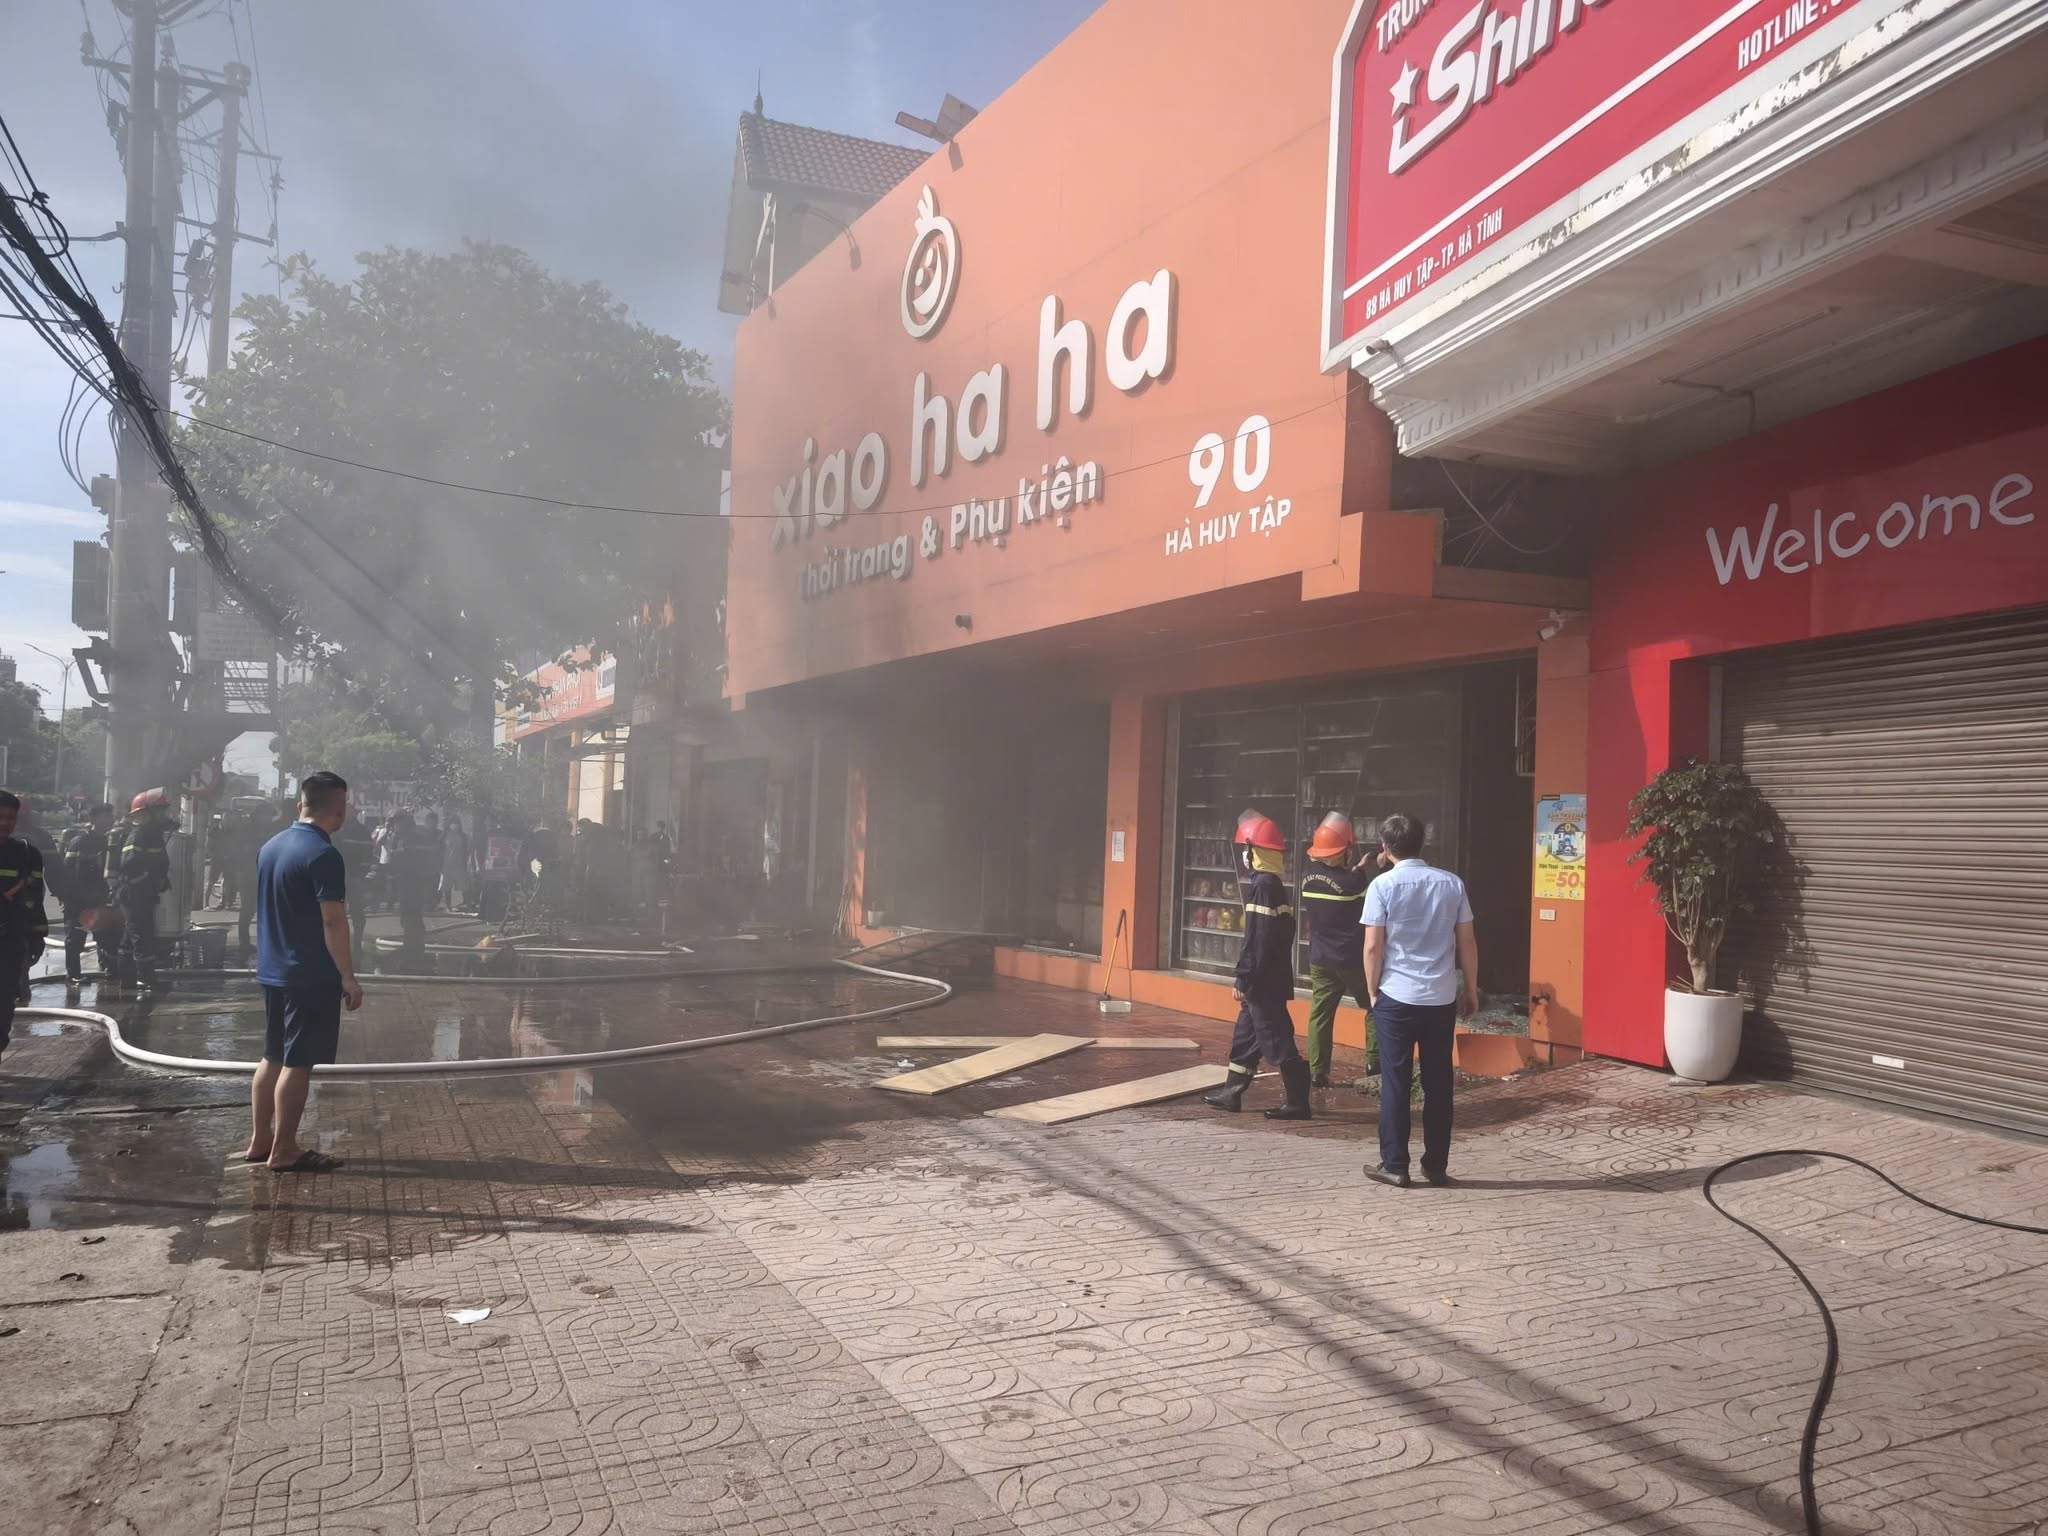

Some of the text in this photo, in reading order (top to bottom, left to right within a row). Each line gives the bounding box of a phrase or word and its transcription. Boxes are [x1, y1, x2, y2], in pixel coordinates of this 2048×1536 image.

[1388, 0, 1597, 174] Shin
[1365, 295, 1378, 320] 88
[1379, 282, 1391, 311] HÀ
[1393, 271, 1413, 302] HUY
[1476, 207, 1503, 244] TĨNH
[771, 268, 1171, 549] xiao ha ha
[1188, 414, 1271, 509] 90
[797, 455, 1098, 602] hời trang & Phụ kiện
[1165, 495, 1292, 556] HÀ HUY TẬP
[1705, 473, 2035, 585] Welcome
